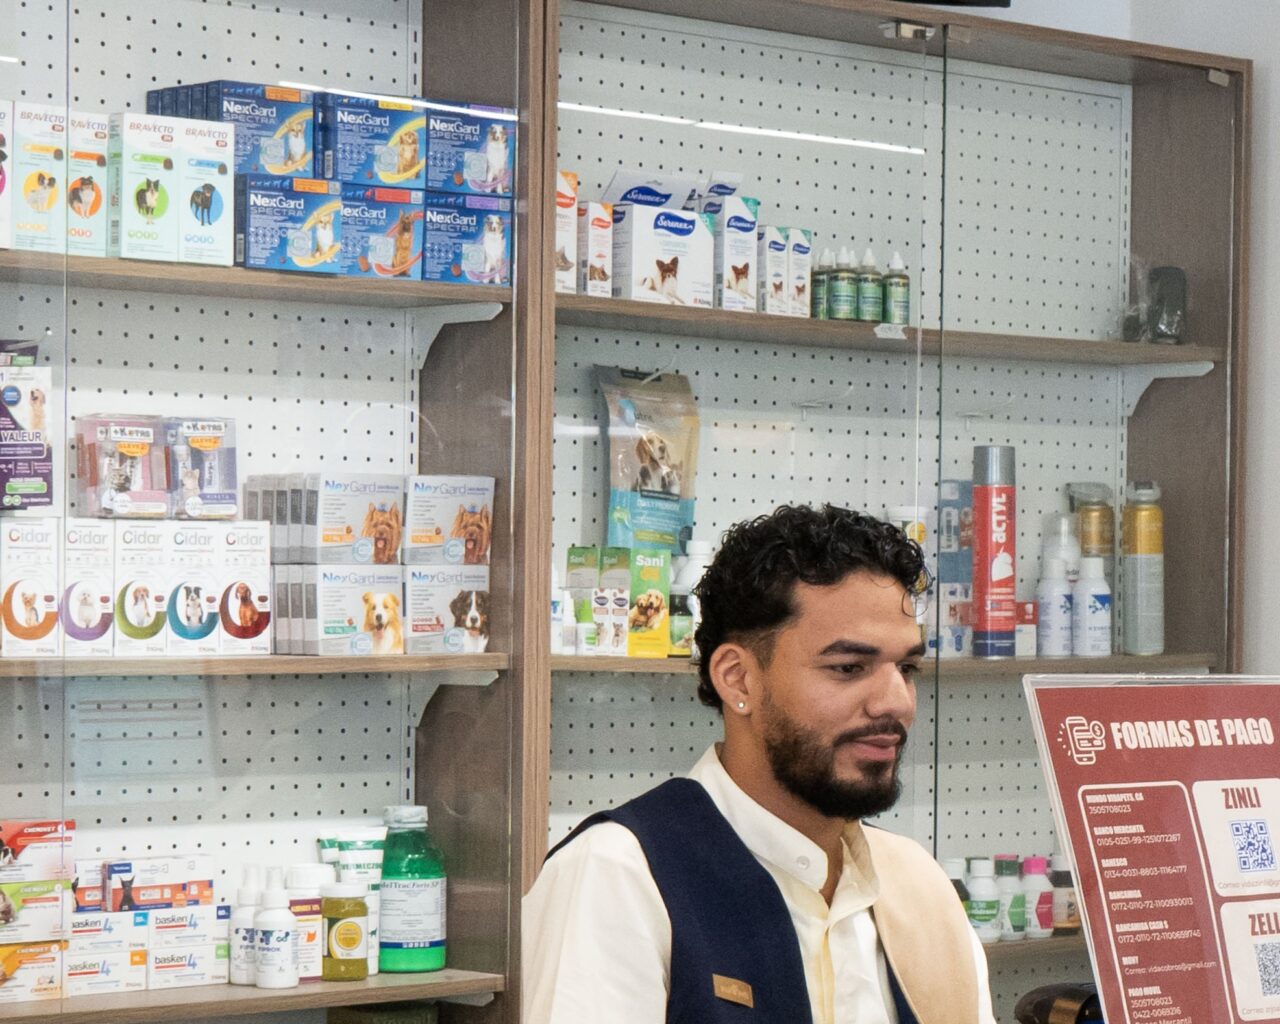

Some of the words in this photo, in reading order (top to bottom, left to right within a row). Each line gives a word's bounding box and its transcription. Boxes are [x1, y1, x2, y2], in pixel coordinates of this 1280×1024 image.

[223, 100, 276, 118] NexGard
[20, 111, 65, 123] BRAVECTO
[337, 111, 389, 126] NexGard
[70, 119, 107, 131] RAVECTO
[129, 122, 174, 134] BRAVECTO
[429, 118, 480, 135] NexGard
[185, 127, 228, 139] BRAVECTO
[250, 194, 304, 209] NexGard
[426, 211, 477, 226] NexGard
[9, 528, 50, 543] Cidar
[67, 529, 107, 545] Cidar
[122, 530, 163, 545] Cidar
[174, 531, 213, 546] Cidar
[226, 531, 264, 546] Cidar
[636, 555, 664, 567] Sani
[1111, 720, 1195, 749] FORMAS
[1194, 719, 1222, 746] DE
[1222, 718, 1275, 745] PAGO
[1222, 787, 1262, 809] ZINLI
[155, 914, 187, 925] basken
[188, 914, 198, 929] 4
[155, 953, 187, 964] basken
[187, 953, 197, 969] 4
